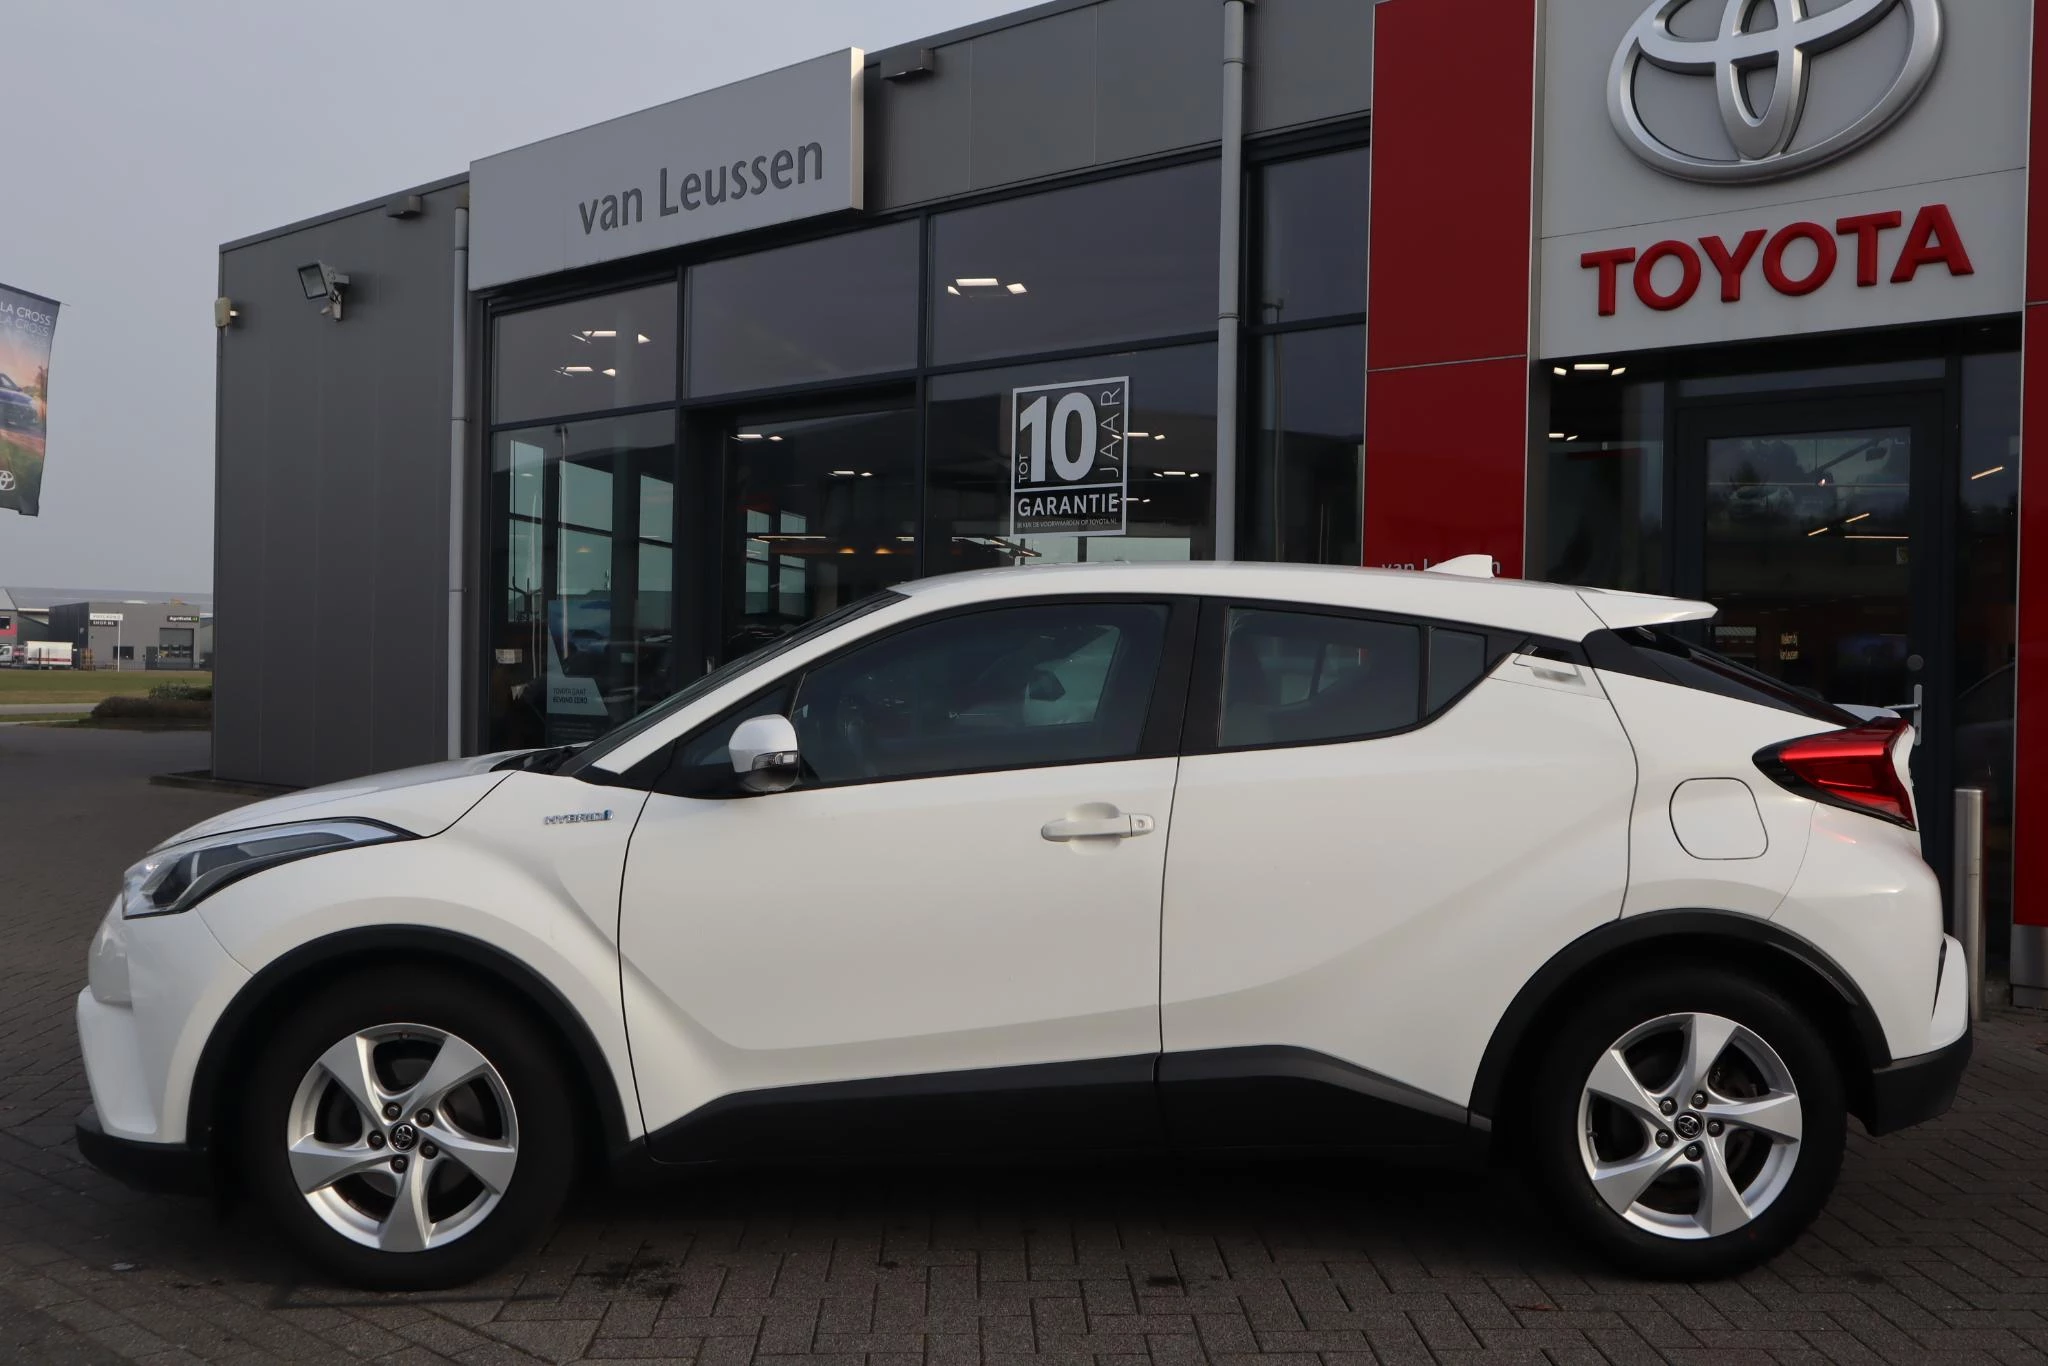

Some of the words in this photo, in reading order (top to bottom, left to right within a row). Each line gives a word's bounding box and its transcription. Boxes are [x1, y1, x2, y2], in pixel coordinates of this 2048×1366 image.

[578, 186, 644, 236] van
[659, 141, 823, 218] Leussen
[1580, 203, 1975, 318] TOYOTA
[17, 306, 51, 326] CROSS
[1018, 454, 1029, 484] TOT
[1019, 392, 1097, 483] 10
[1099, 387, 1121, 478] JAAR
[1017, 493, 1118, 517] GARANTIE
